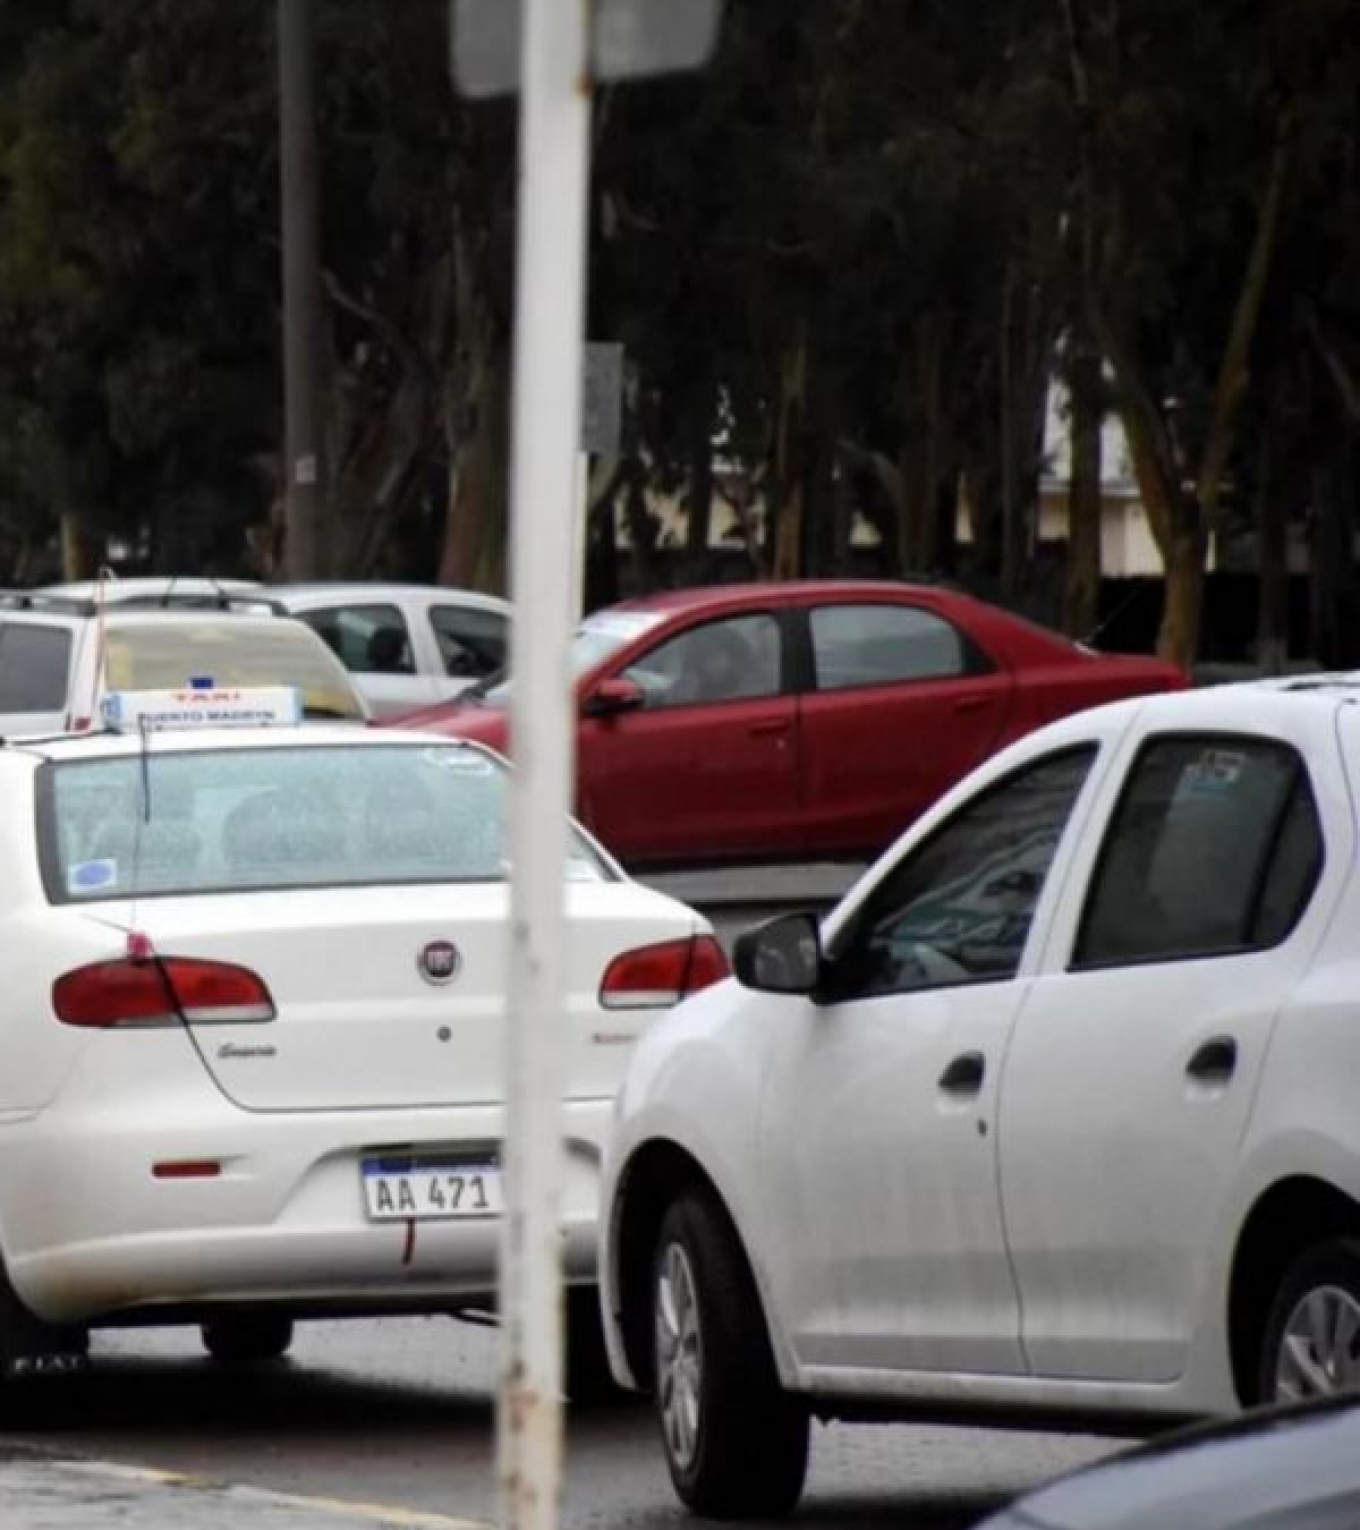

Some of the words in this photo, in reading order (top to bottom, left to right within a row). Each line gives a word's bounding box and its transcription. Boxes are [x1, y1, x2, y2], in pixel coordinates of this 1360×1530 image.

[207, 710, 276, 722] MADRYN
[376, 1178, 416, 1211] AA
[429, 1175, 488, 1209] 471
